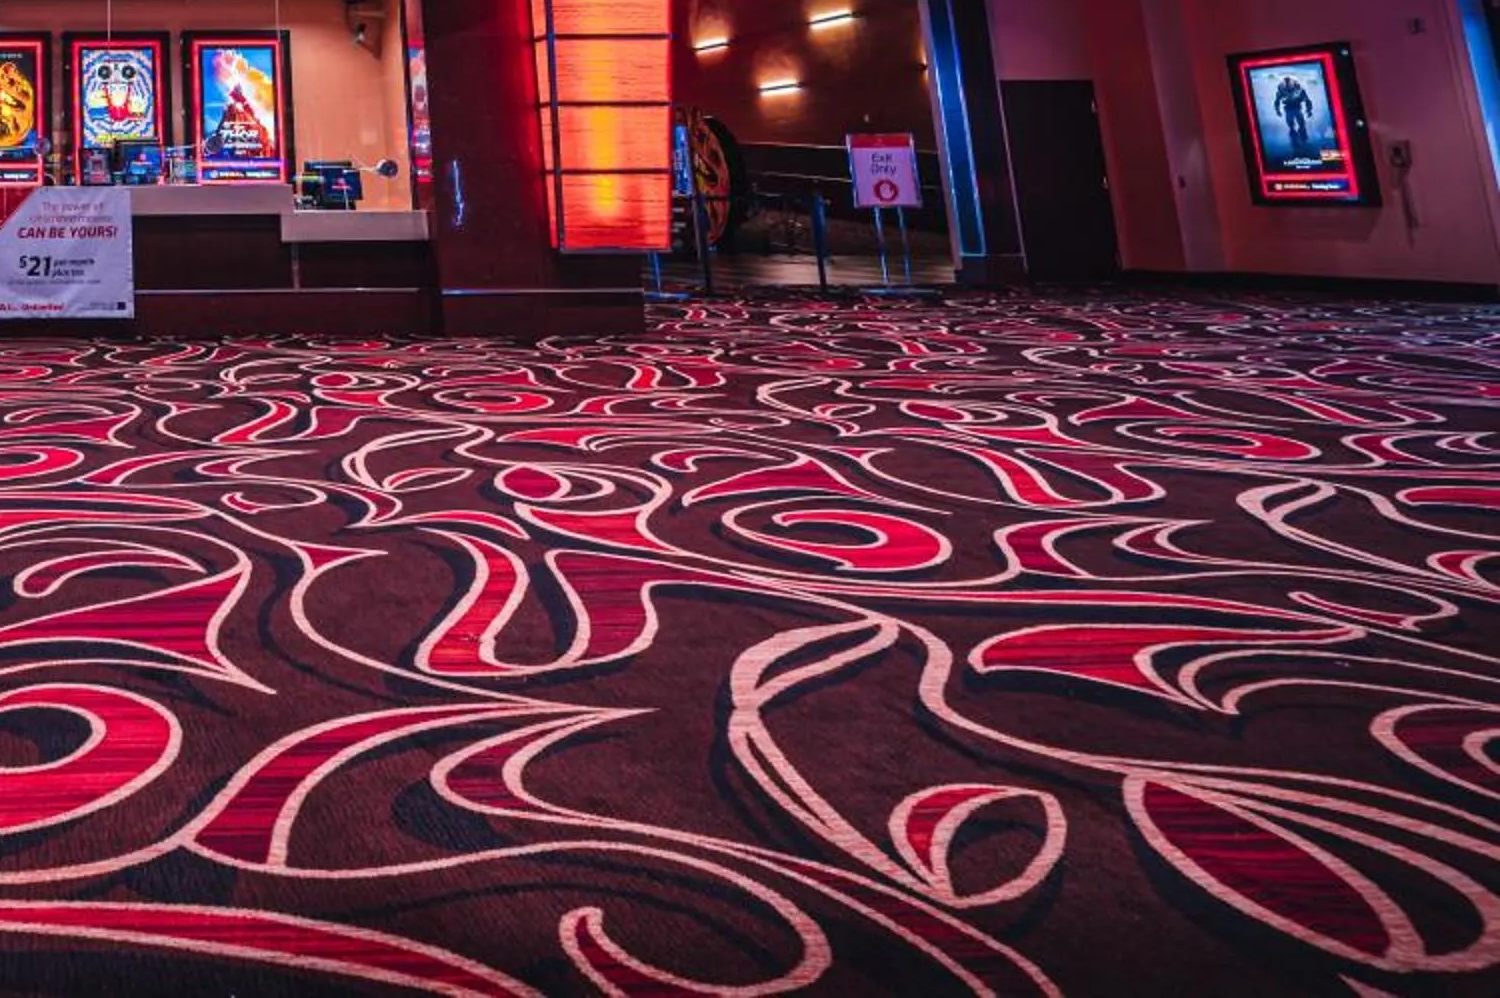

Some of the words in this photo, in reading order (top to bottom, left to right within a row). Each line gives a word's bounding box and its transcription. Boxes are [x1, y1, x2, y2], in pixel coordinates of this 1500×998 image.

[871, 153, 893, 163] Exit
[871, 164, 897, 175] Only
[17, 226, 45, 239] CAN
[48, 226, 66, 238] BE
[69, 225, 118, 238] YOURS!
